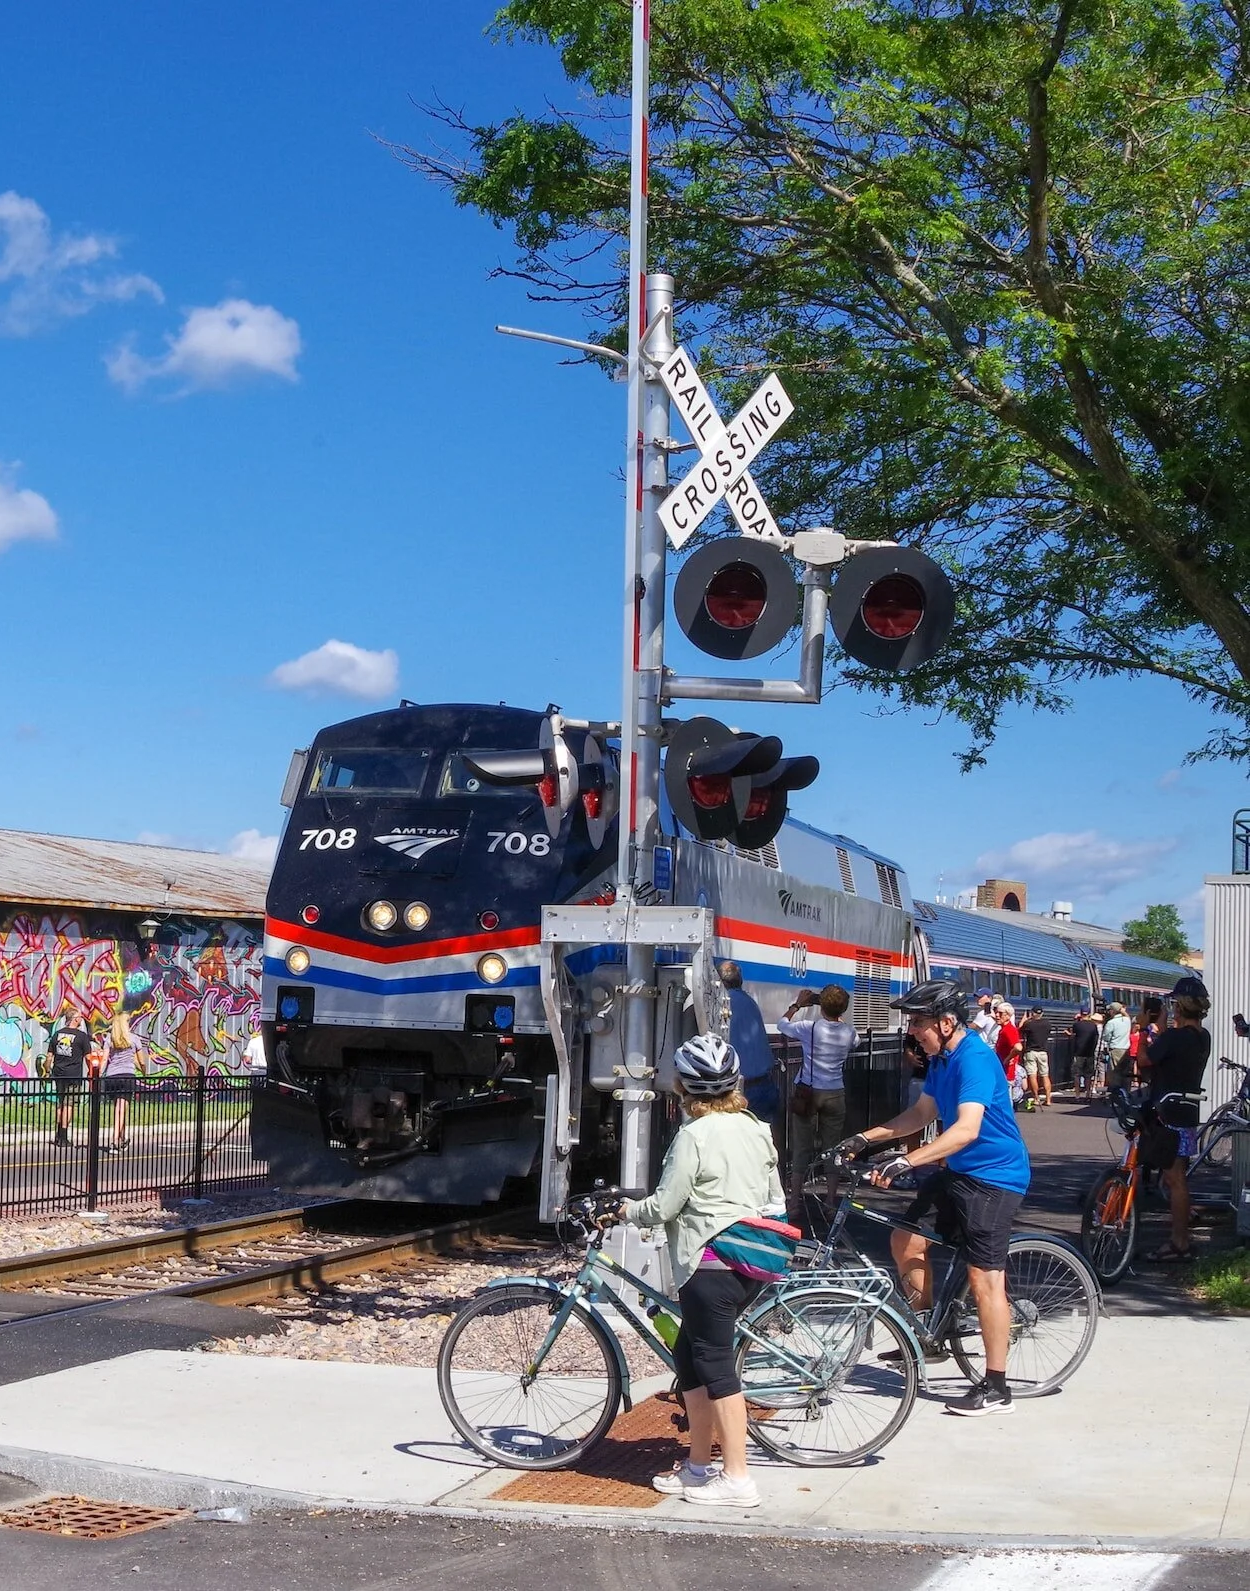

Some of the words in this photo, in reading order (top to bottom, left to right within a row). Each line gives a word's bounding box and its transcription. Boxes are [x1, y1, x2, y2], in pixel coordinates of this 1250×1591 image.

[667, 357, 712, 442] RAIL
[671, 391, 781, 530] CROSSING
[730, 475, 774, 536] ROA
[299, 827, 357, 851] 708
[390, 827, 460, 836] AMTRAK
[486, 831, 551, 857] 708
[790, 901, 822, 922] AMTRAK
[789, 940, 808, 979] 708
